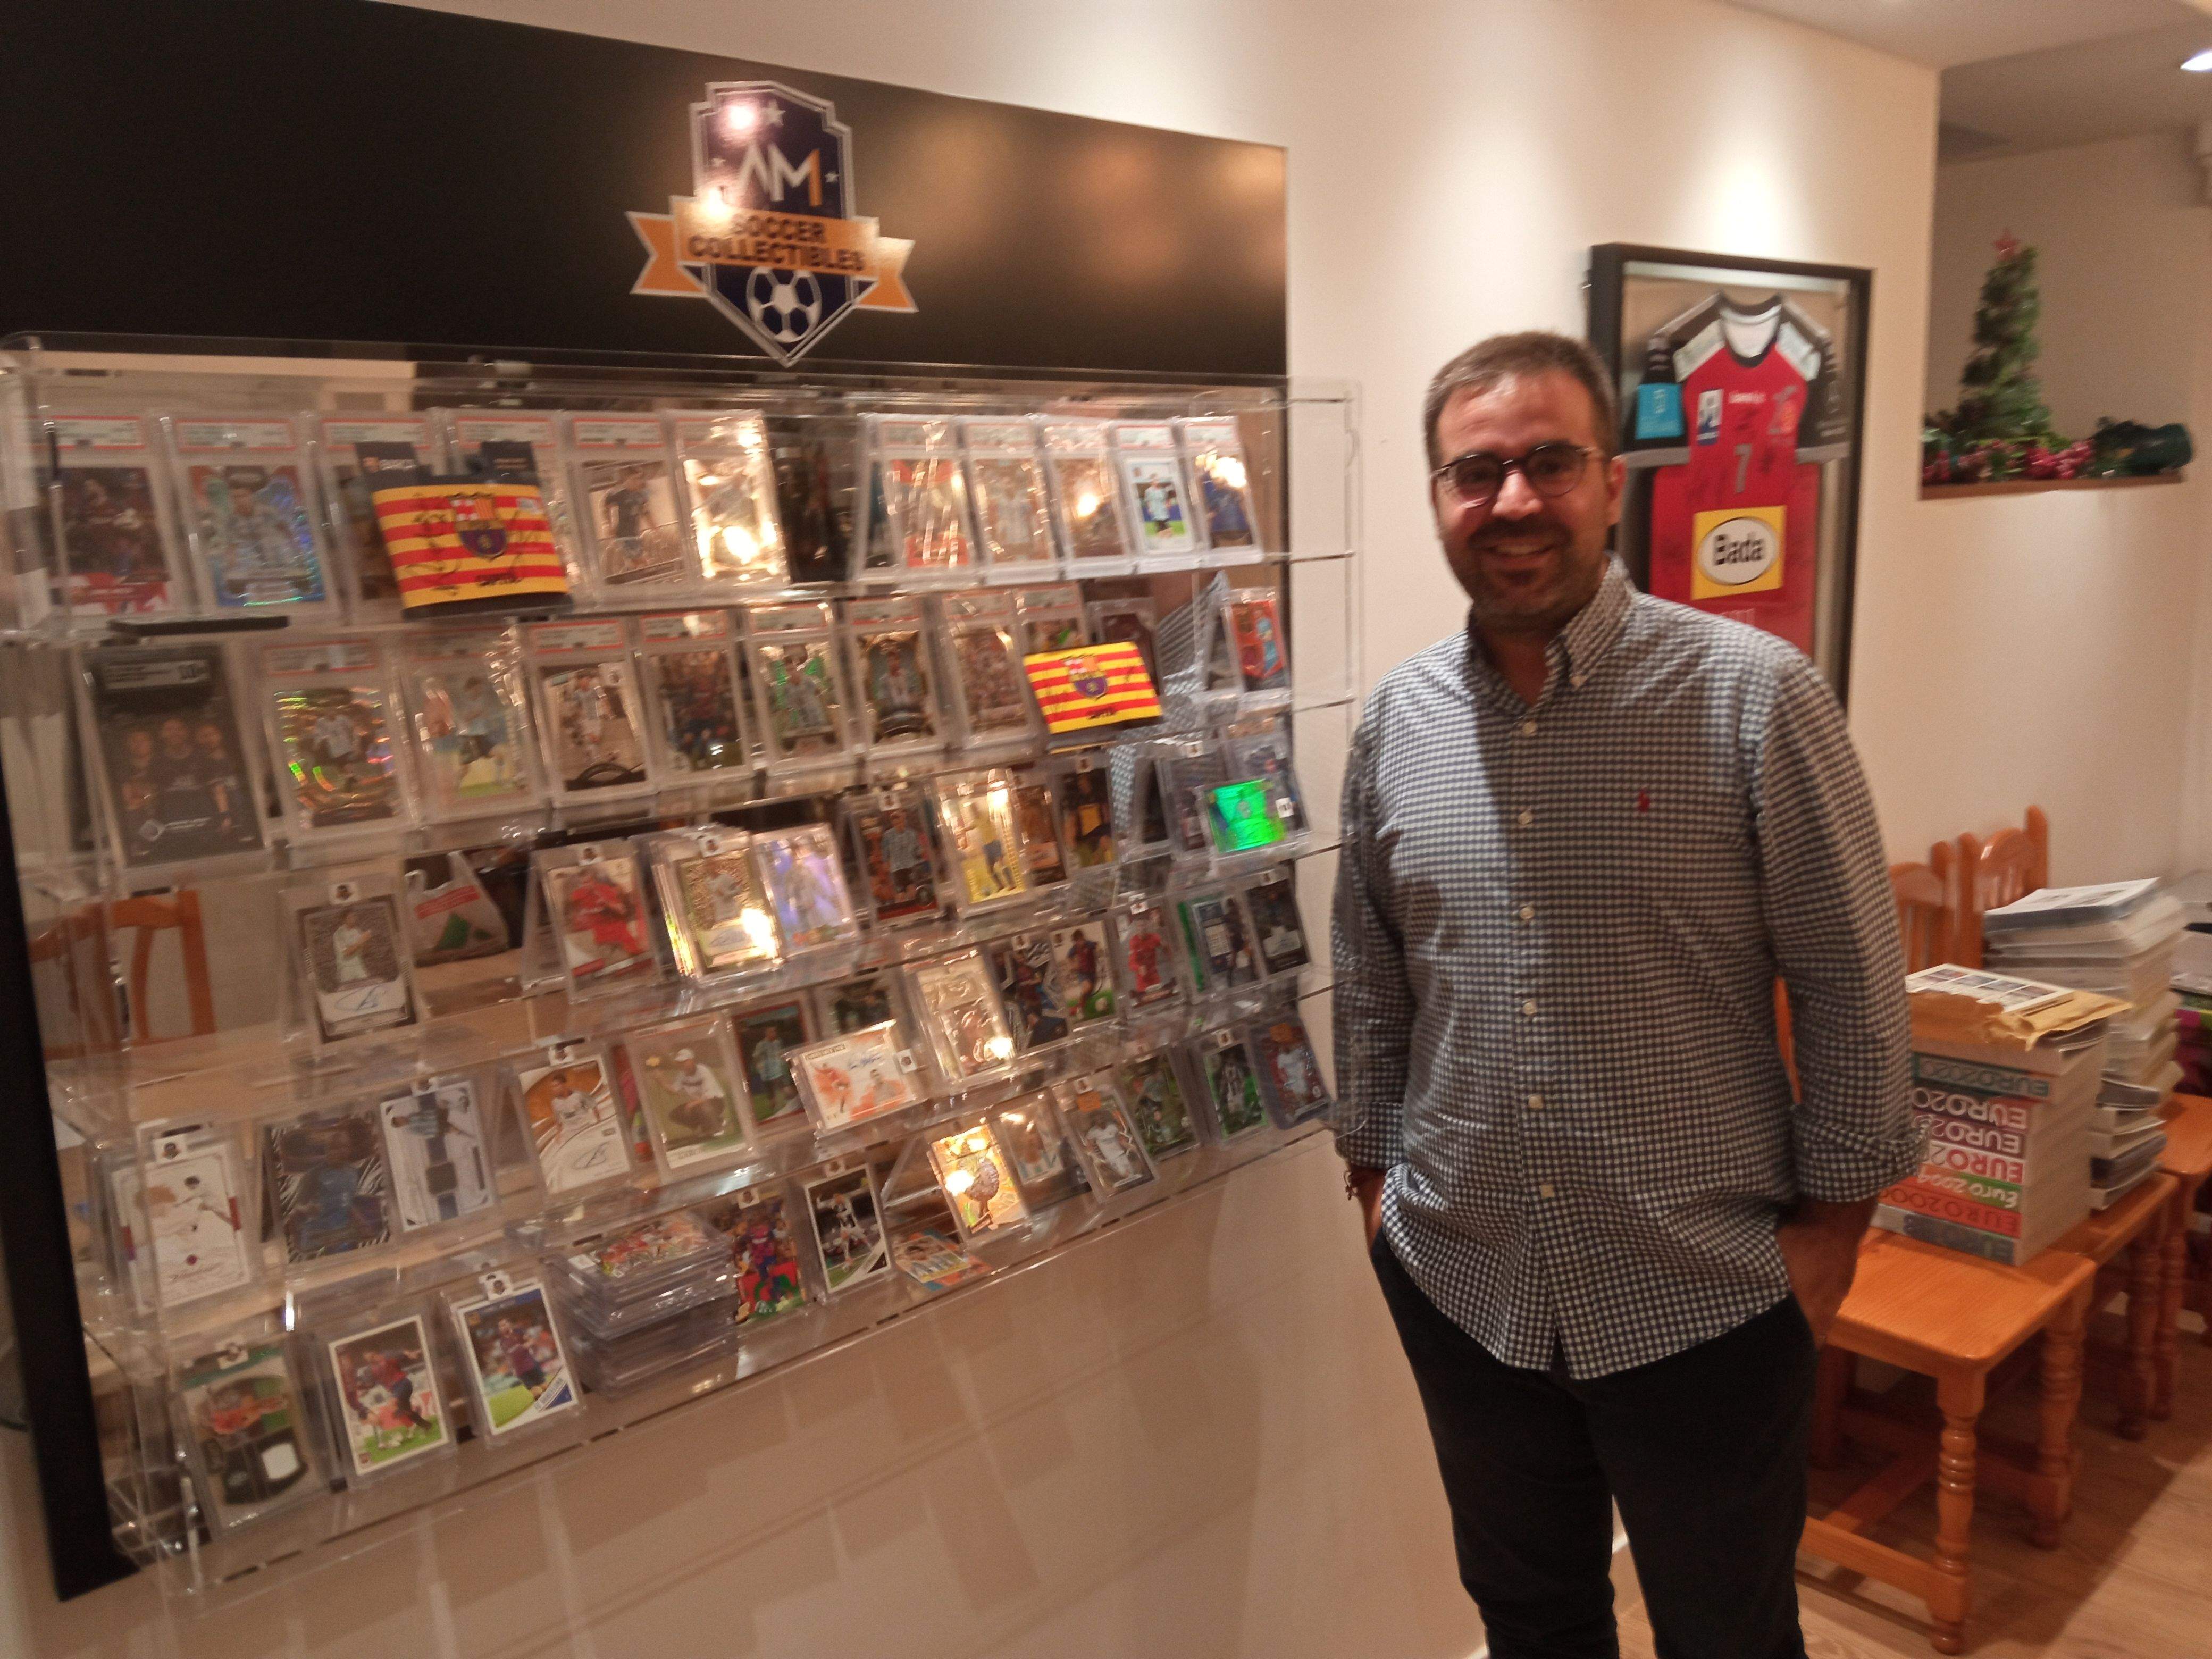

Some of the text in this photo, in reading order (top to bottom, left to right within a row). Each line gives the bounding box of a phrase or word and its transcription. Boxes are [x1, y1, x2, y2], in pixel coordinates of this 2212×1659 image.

[732, 214, 825, 243] SOCCER
[688, 235, 865, 271] COLLECTIBLES
[1734, 443, 1752, 493] 7
